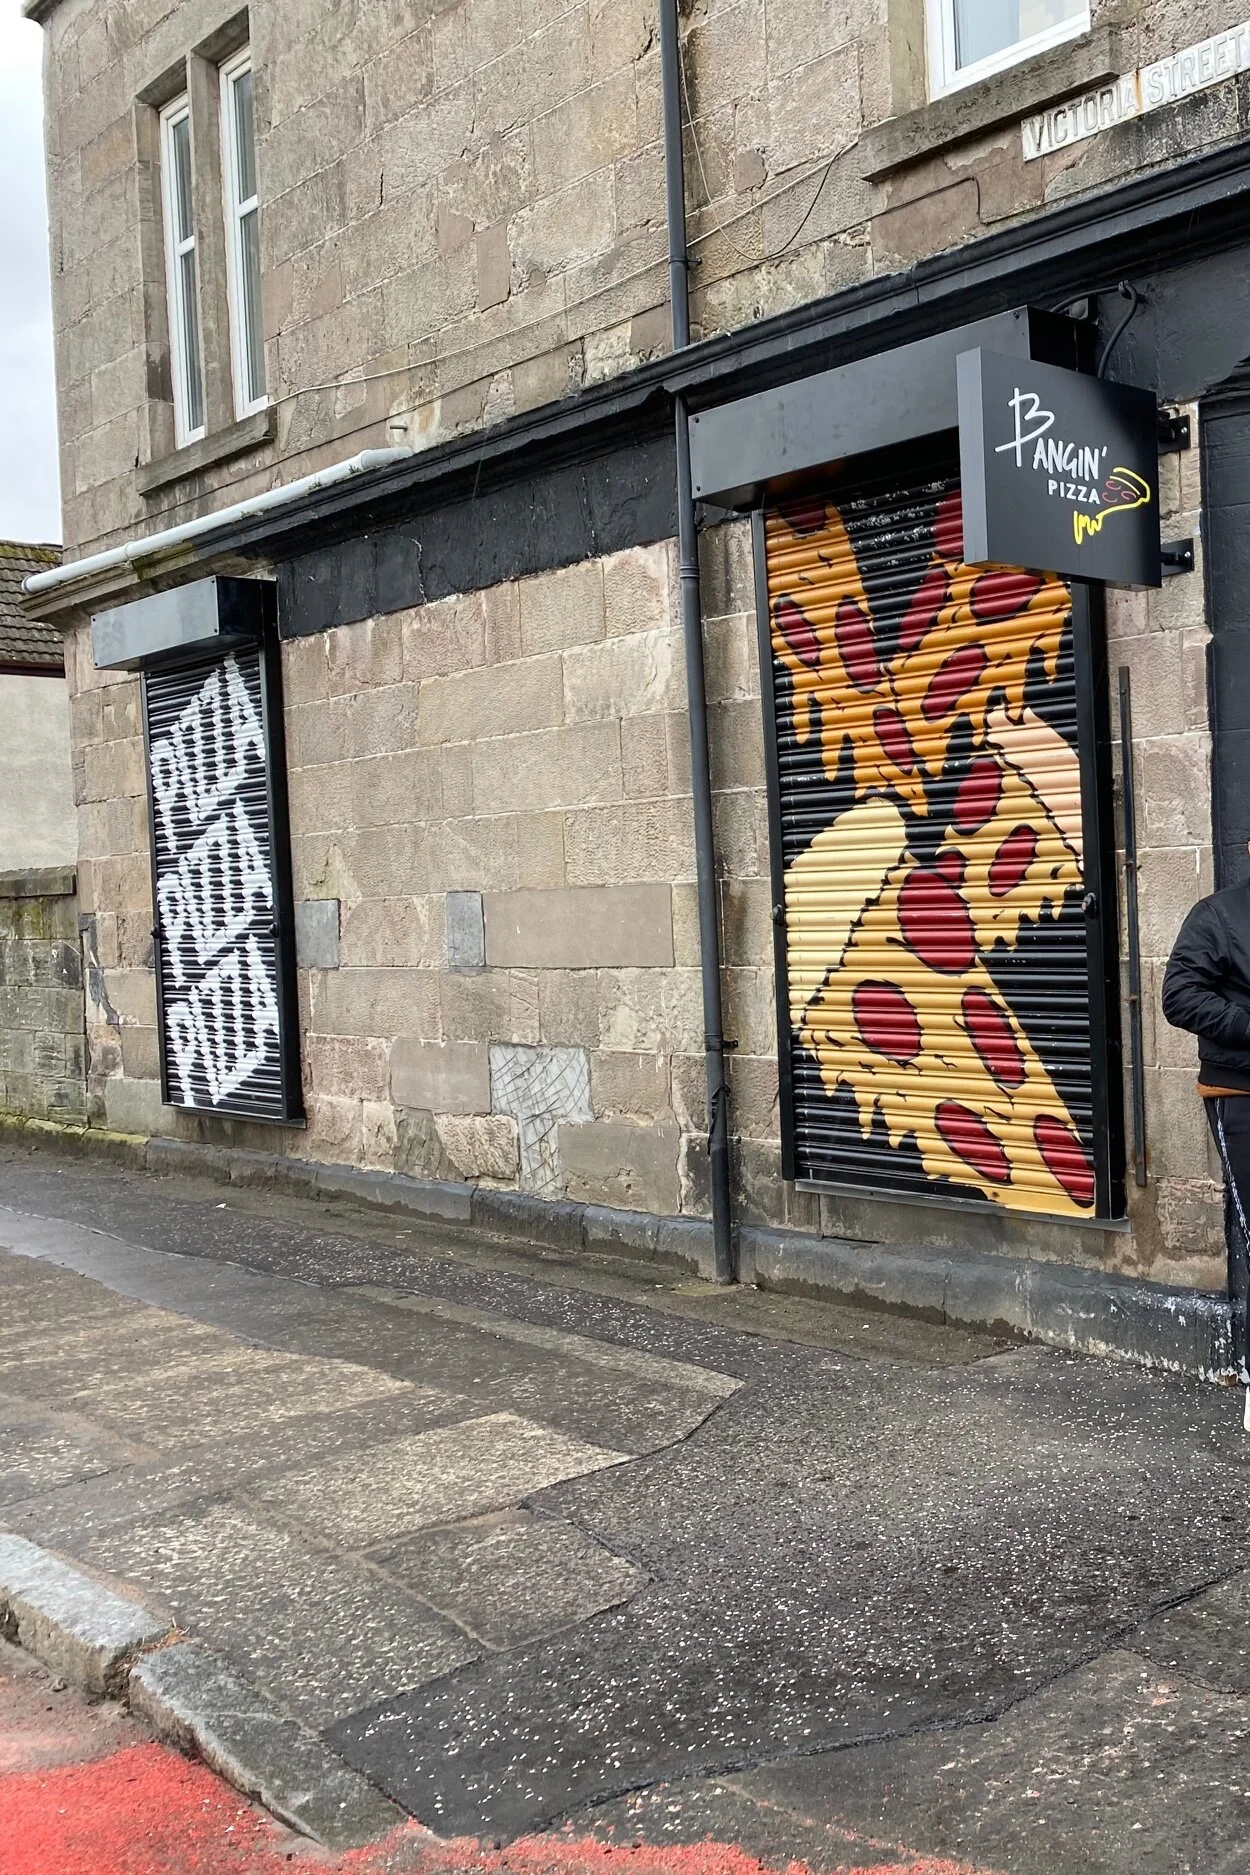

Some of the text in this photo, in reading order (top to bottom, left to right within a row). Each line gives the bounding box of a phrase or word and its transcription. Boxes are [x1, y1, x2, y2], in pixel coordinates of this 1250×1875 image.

[1027, 29, 1246, 153] VICTORIA STREET
[1048, 479, 1101, 504] PIZZA
[150, 652, 266, 854] PIZZA
[157, 798, 273, 989] PIZZA
[166, 933, 279, 1107] PIZZA
